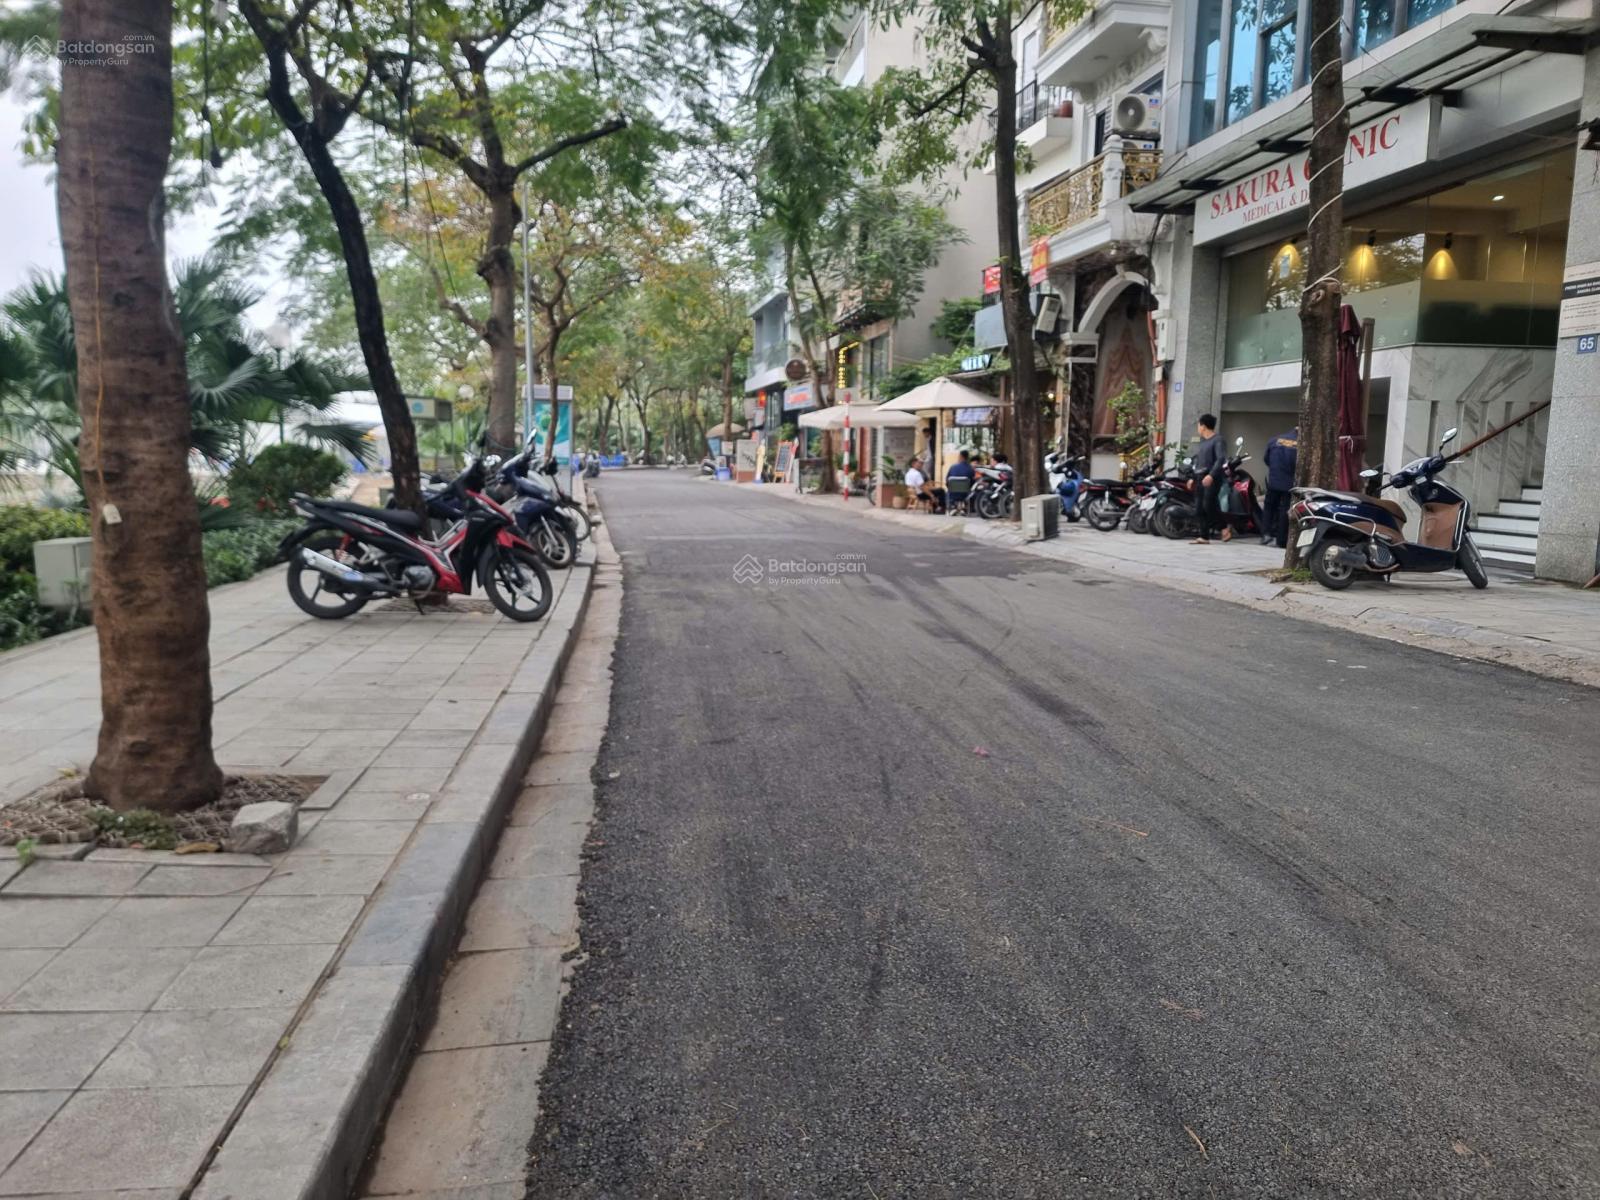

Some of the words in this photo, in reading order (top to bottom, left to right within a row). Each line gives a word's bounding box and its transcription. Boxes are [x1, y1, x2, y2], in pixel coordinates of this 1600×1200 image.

[1210, 163, 1295, 220] SAKURA
[1242, 197, 1287, 225] MEDICAL
[1580, 337, 1595, 350] 65
